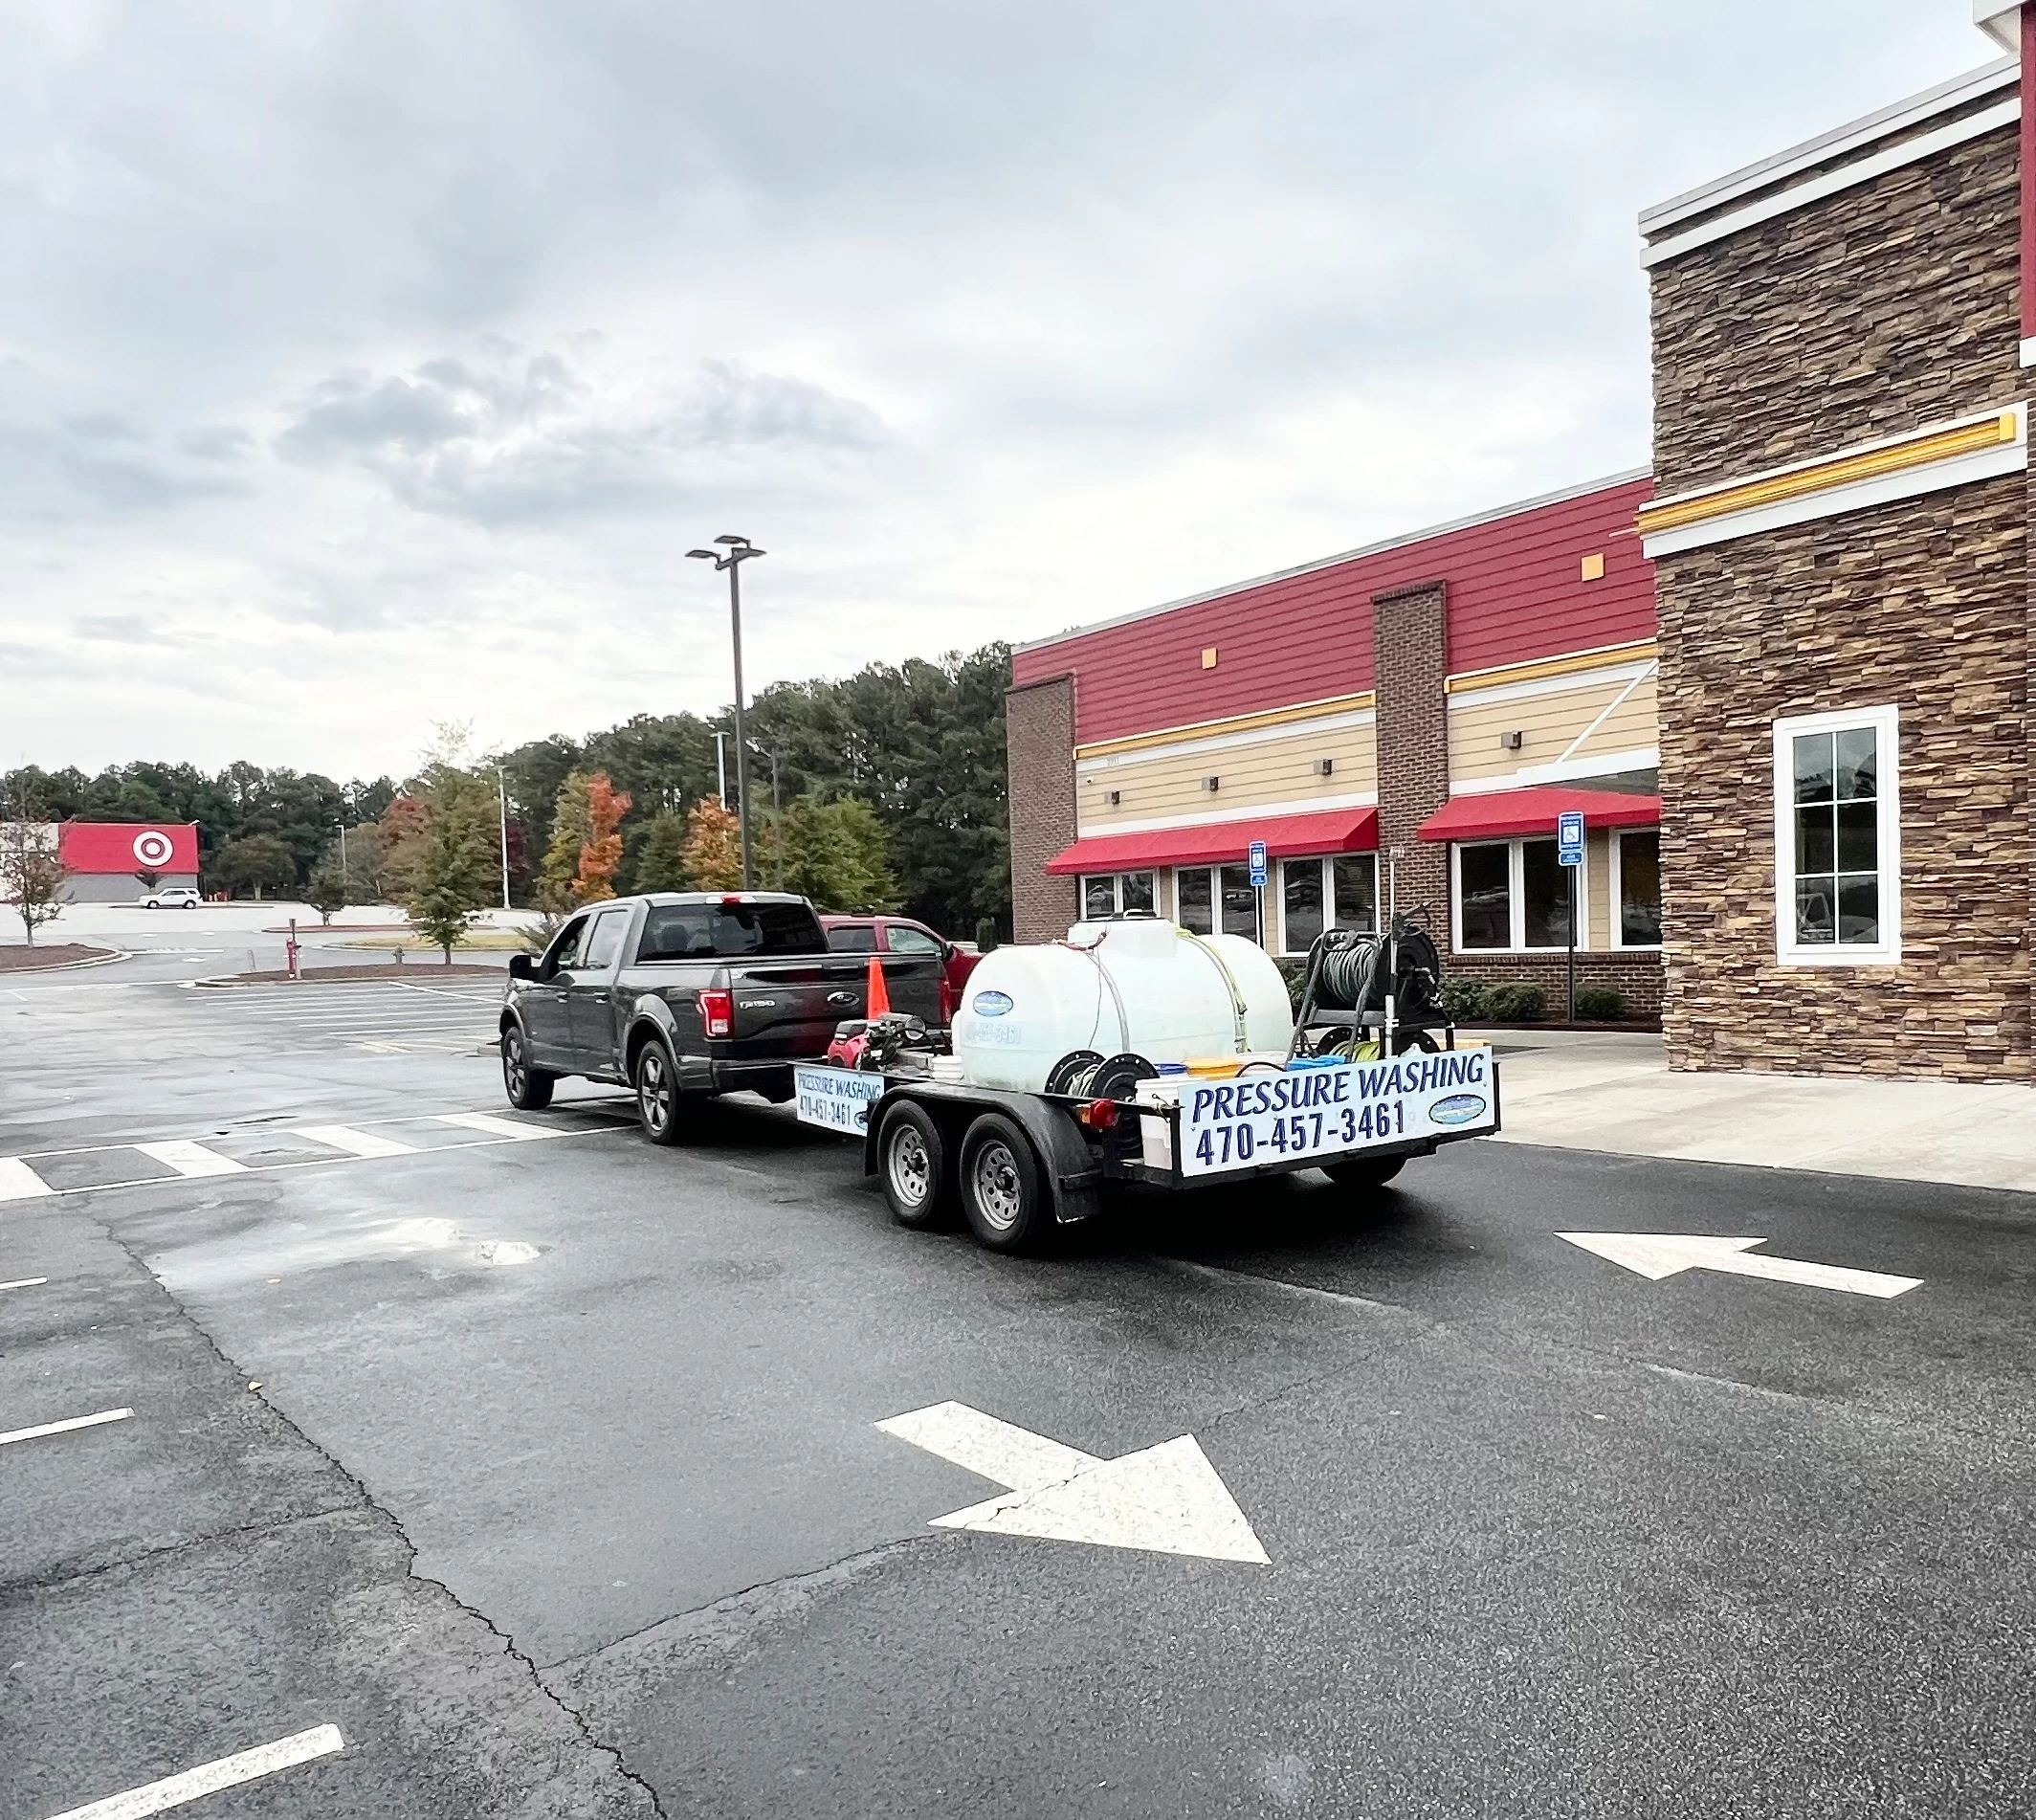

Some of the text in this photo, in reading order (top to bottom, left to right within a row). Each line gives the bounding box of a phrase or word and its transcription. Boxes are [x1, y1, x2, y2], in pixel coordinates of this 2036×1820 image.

[964, 1023, 1021, 1045] --3461
[797, 1072, 880, 1100] PRESSURE WASHING
[1192, 1054, 1484, 1123] PRESSURE WASHING
[799, 1095, 851, 1125] 470-457-3461
[1196, 1099, 1404, 1165] 470-457-3461
